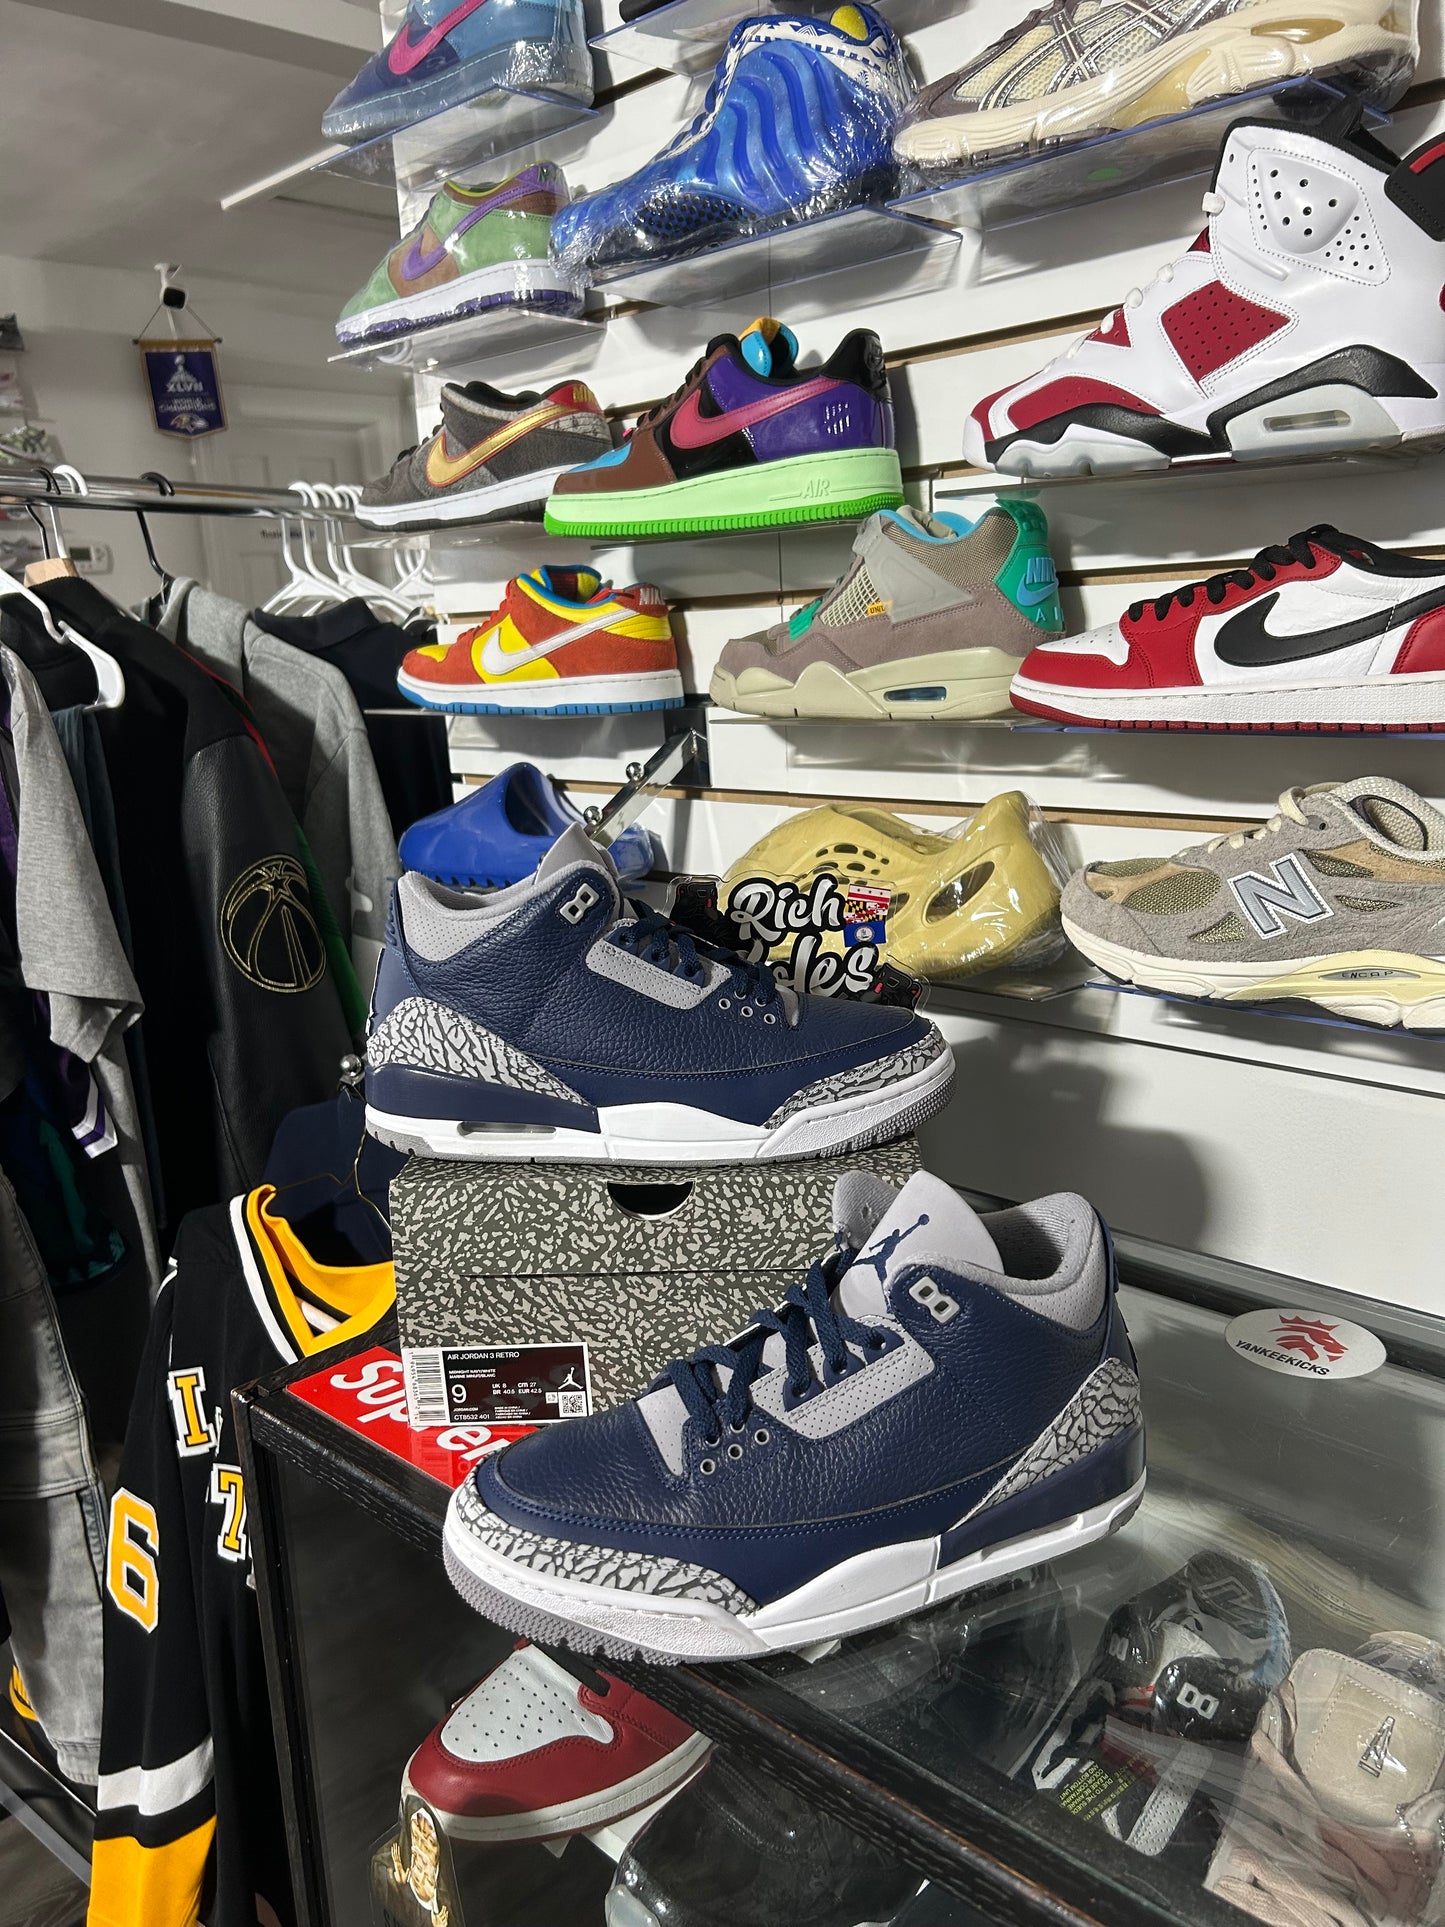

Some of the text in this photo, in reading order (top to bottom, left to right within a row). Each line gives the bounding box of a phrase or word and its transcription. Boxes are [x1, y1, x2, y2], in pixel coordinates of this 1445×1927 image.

[803, 478, 830, 499] AIR
[1026, 557, 1056, 584] NIK
[1036, 607, 1064, 622] AI
[730, 878, 841, 942] Rich
[1341, 970, 1394, 979] ENCAP
[1236, 1339, 1330, 1376] YANKEEKICKS
[452, 1384, 466, 1403] 9
[106, 1487, 159, 1633] 6
[1070, 1773, 1089, 1789] BOTTOM
[1088, 1768, 1103, 1783] COLOR
[1091, 1773, 1108, 1789] PLEASE
